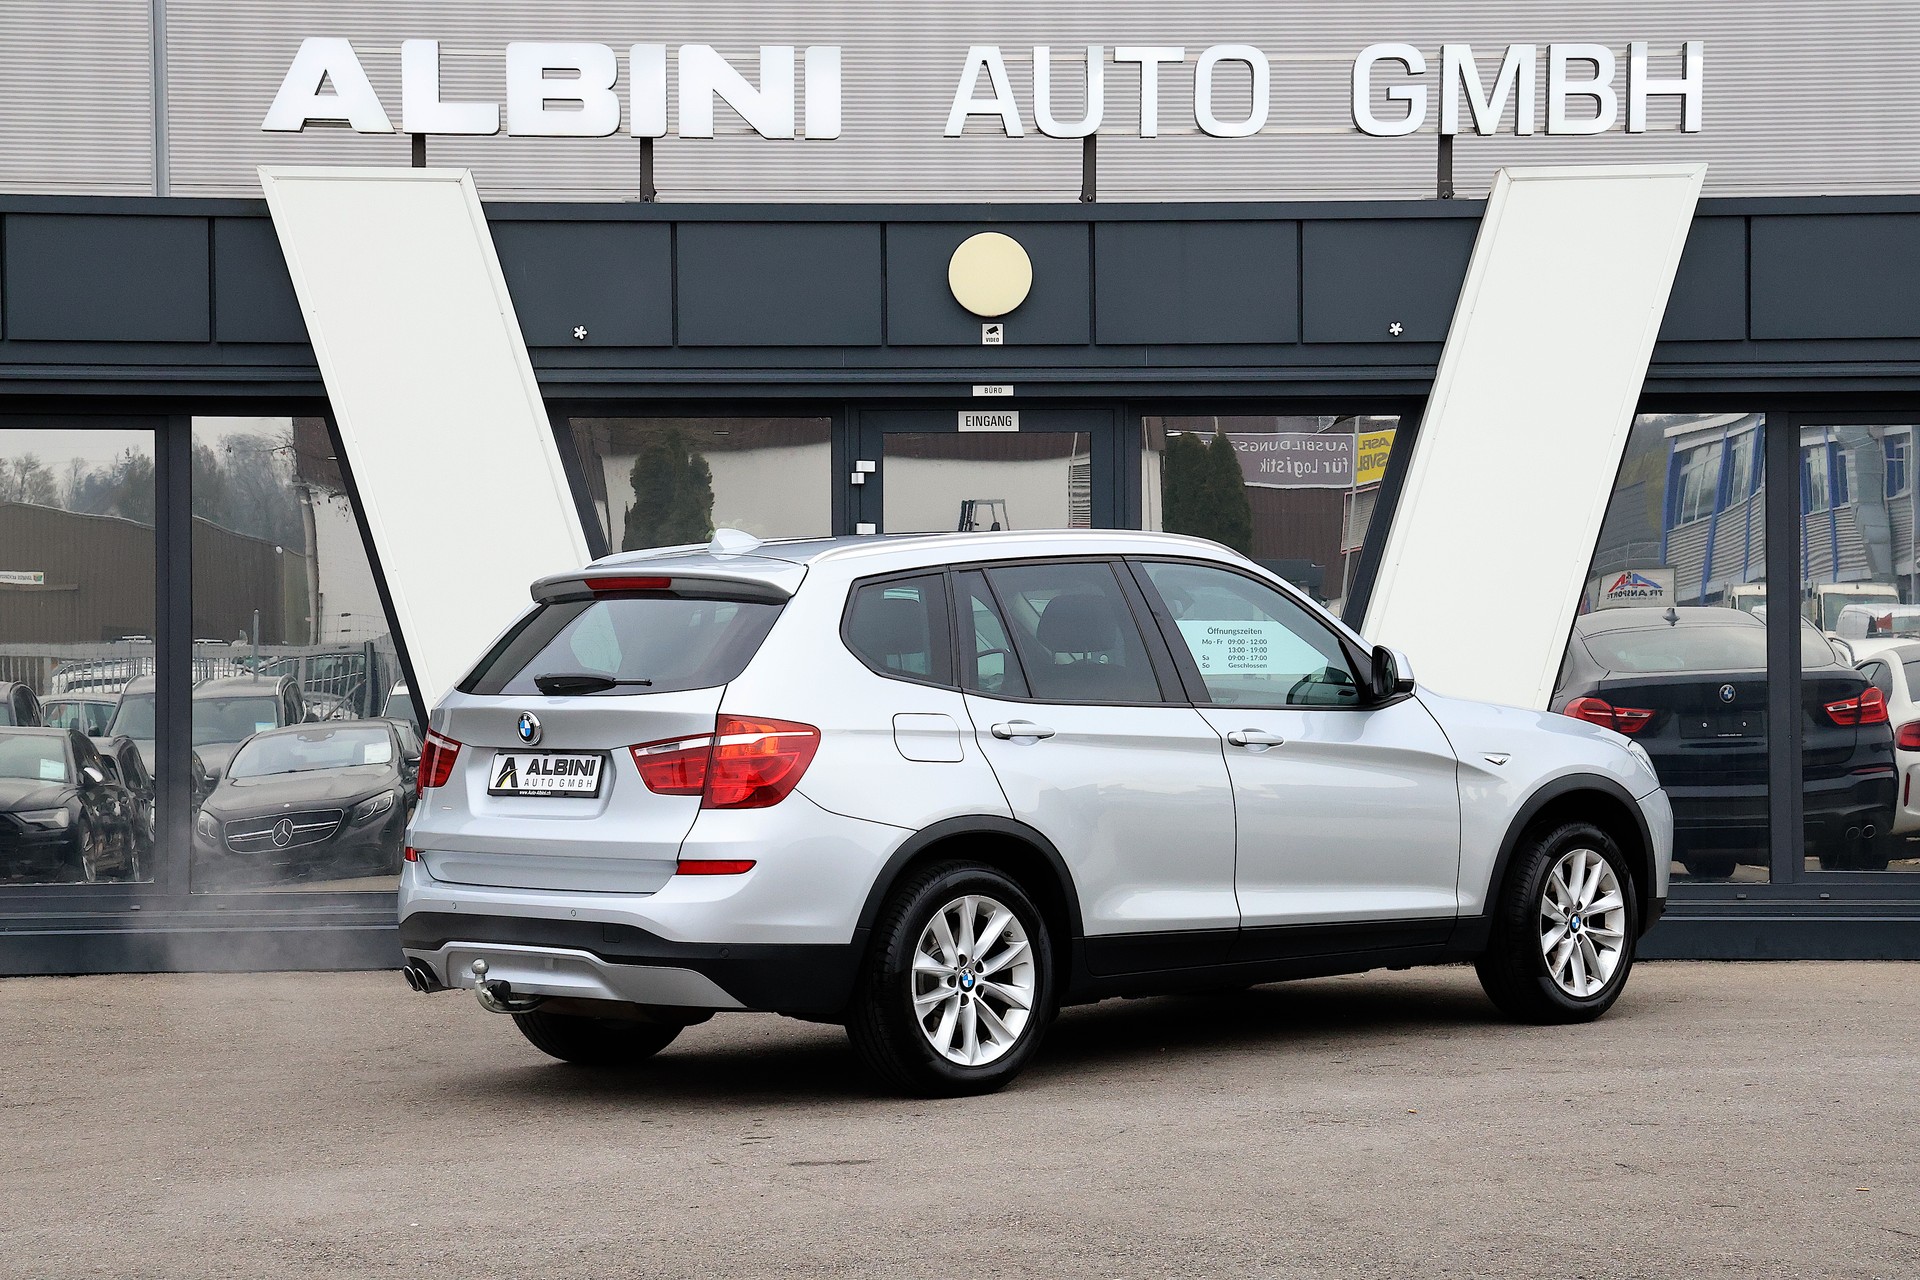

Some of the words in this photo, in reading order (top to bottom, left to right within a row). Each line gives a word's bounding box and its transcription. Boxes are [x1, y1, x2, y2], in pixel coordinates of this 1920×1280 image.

[261, 37, 842, 140] ALBINI
[943, 44, 1271, 139] AUTO
[1351, 40, 1704, 138] GMBH
[984, 386, 1003, 394] BÜRO
[965, 415, 1012, 427] EINGANG
[1207, 626, 1262, 636] Öffnungszeiten
[526, 759, 596, 776] ALBINI
[524, 778, 554, 788] AUTO
[559, 779, 593, 788] GMBH
